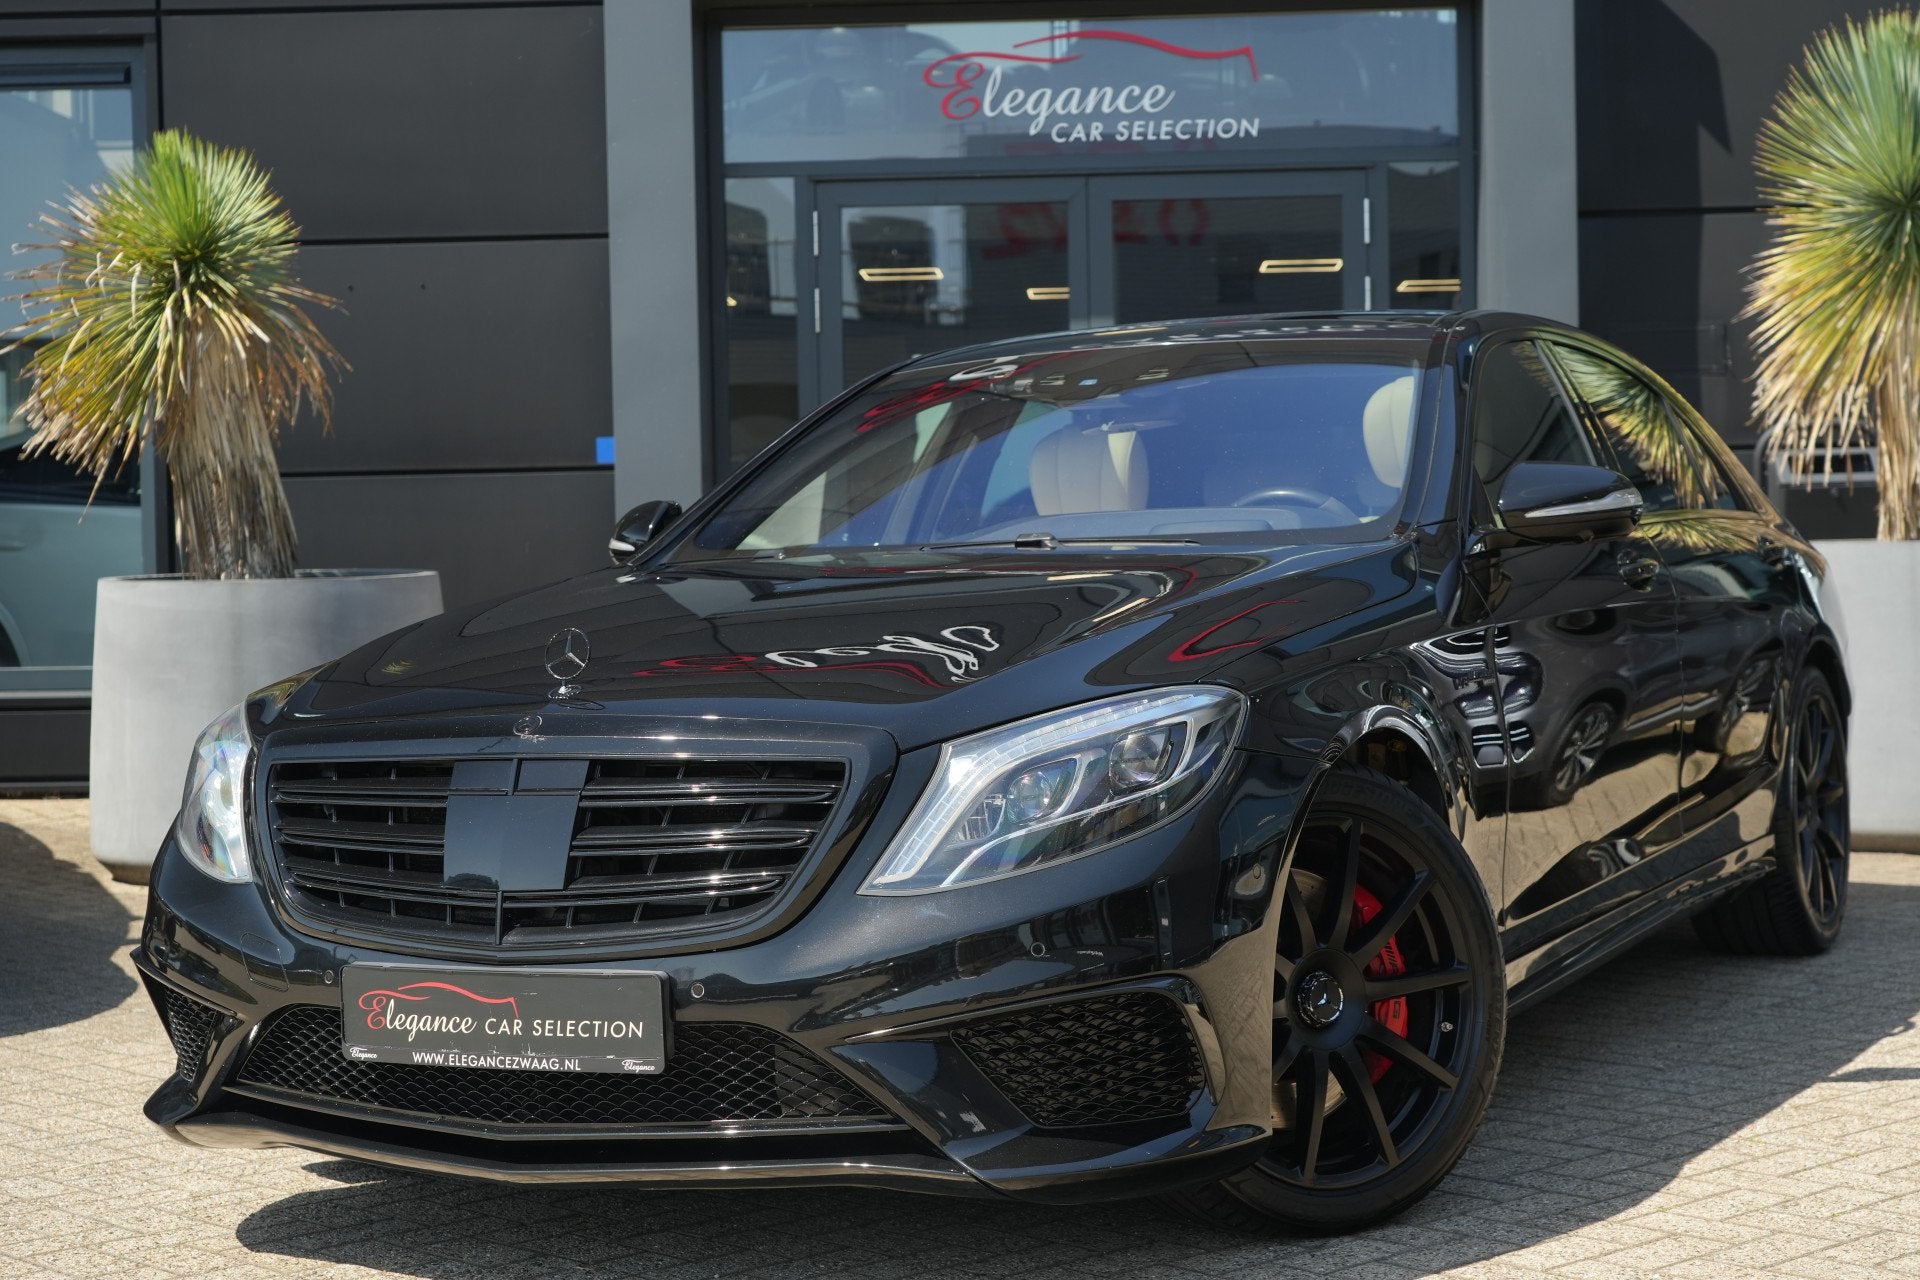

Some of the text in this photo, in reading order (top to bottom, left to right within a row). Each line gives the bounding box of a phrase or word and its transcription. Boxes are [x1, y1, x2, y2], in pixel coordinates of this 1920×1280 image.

[924, 61, 1176, 137] Elegance
[1051, 118, 1260, 144] CAR SELECTION
[359, 996, 644, 1042] Elegance CAR SELECTION
[350, 1047, 378, 1060] Elegance
[412, 1051, 581, 1072] WWW.ELEGANCEZWAAG.NL
[621, 1059, 656, 1073] Elegance
